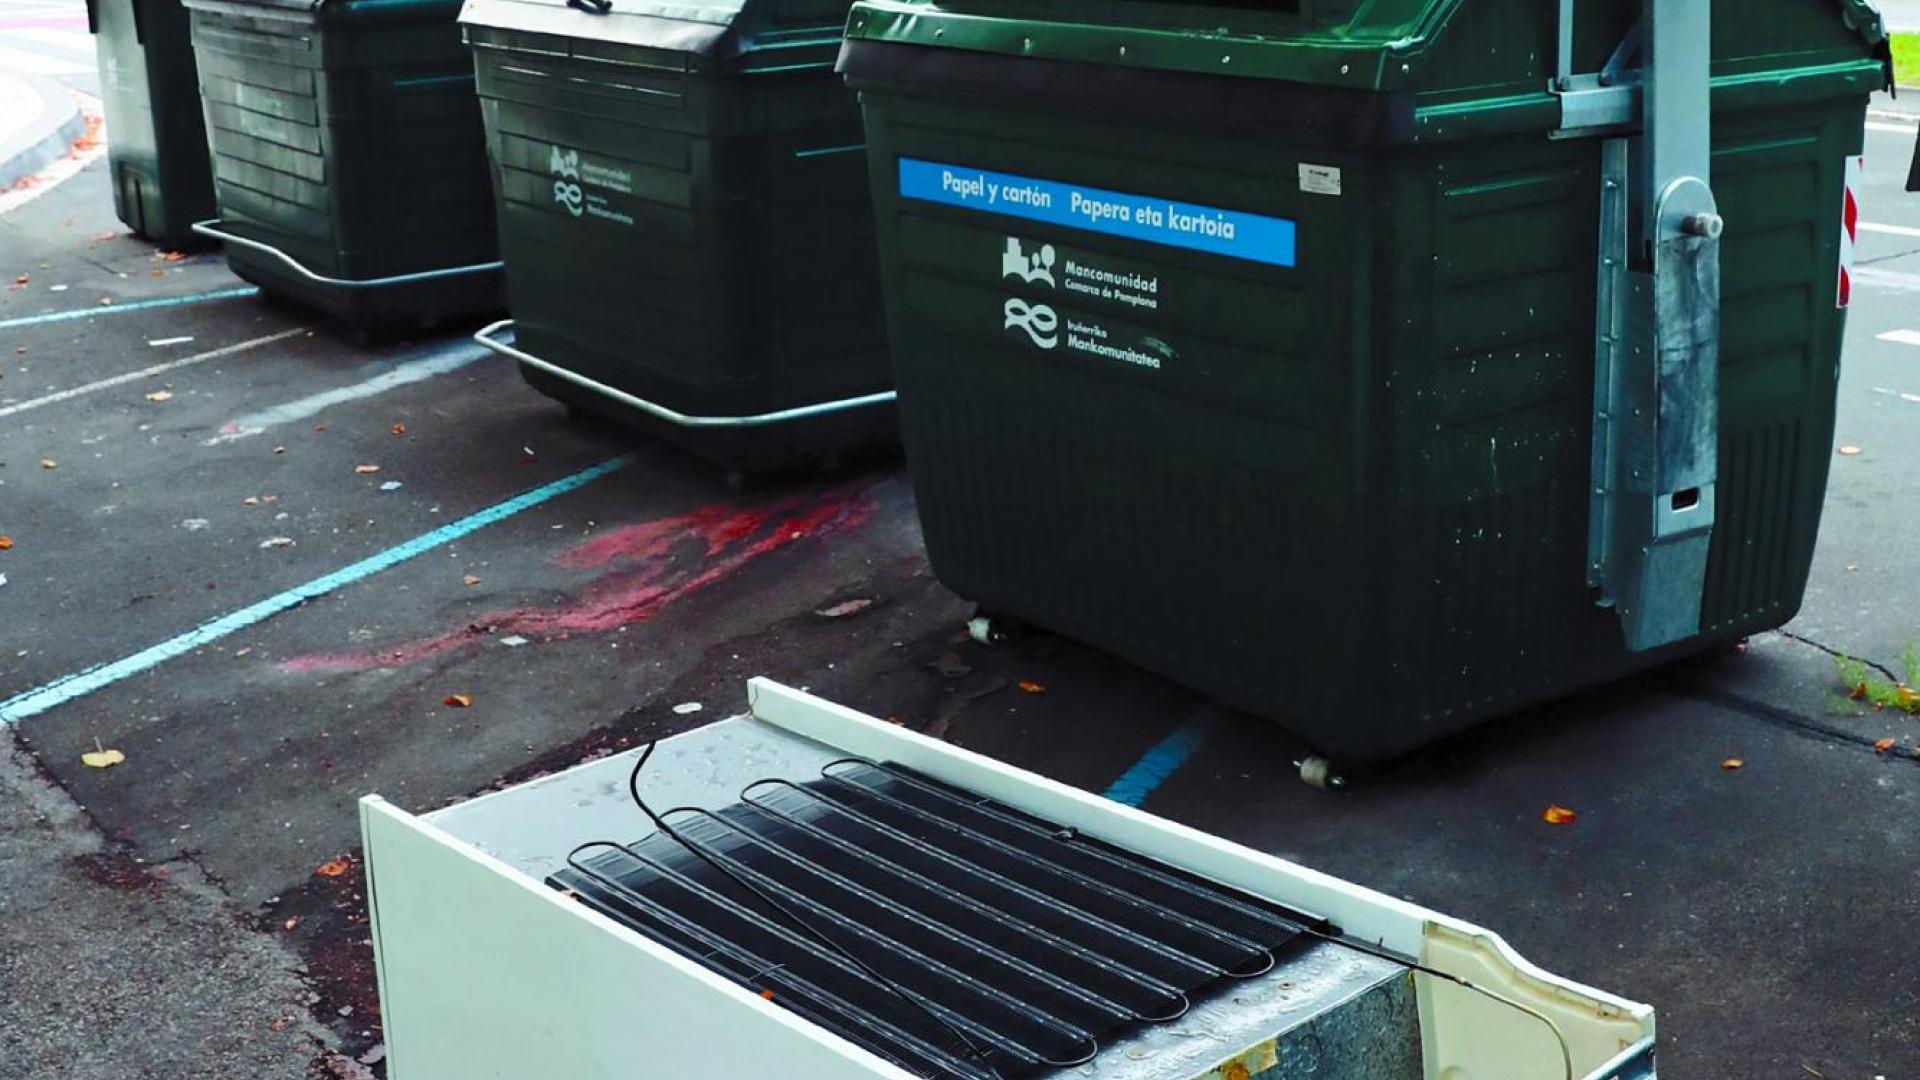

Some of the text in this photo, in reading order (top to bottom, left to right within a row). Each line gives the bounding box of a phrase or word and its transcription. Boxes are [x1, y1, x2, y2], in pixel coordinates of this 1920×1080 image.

[943, 170, 1235, 240] Papel y cartón Papera eta kartoia
[1065, 260, 1157, 293] Mancomunidad
[1101, 286, 1112, 299] de
[1113, 289, 1157, 309] Pamplona
[1067, 333, 1161, 369] Mankomunitatea
